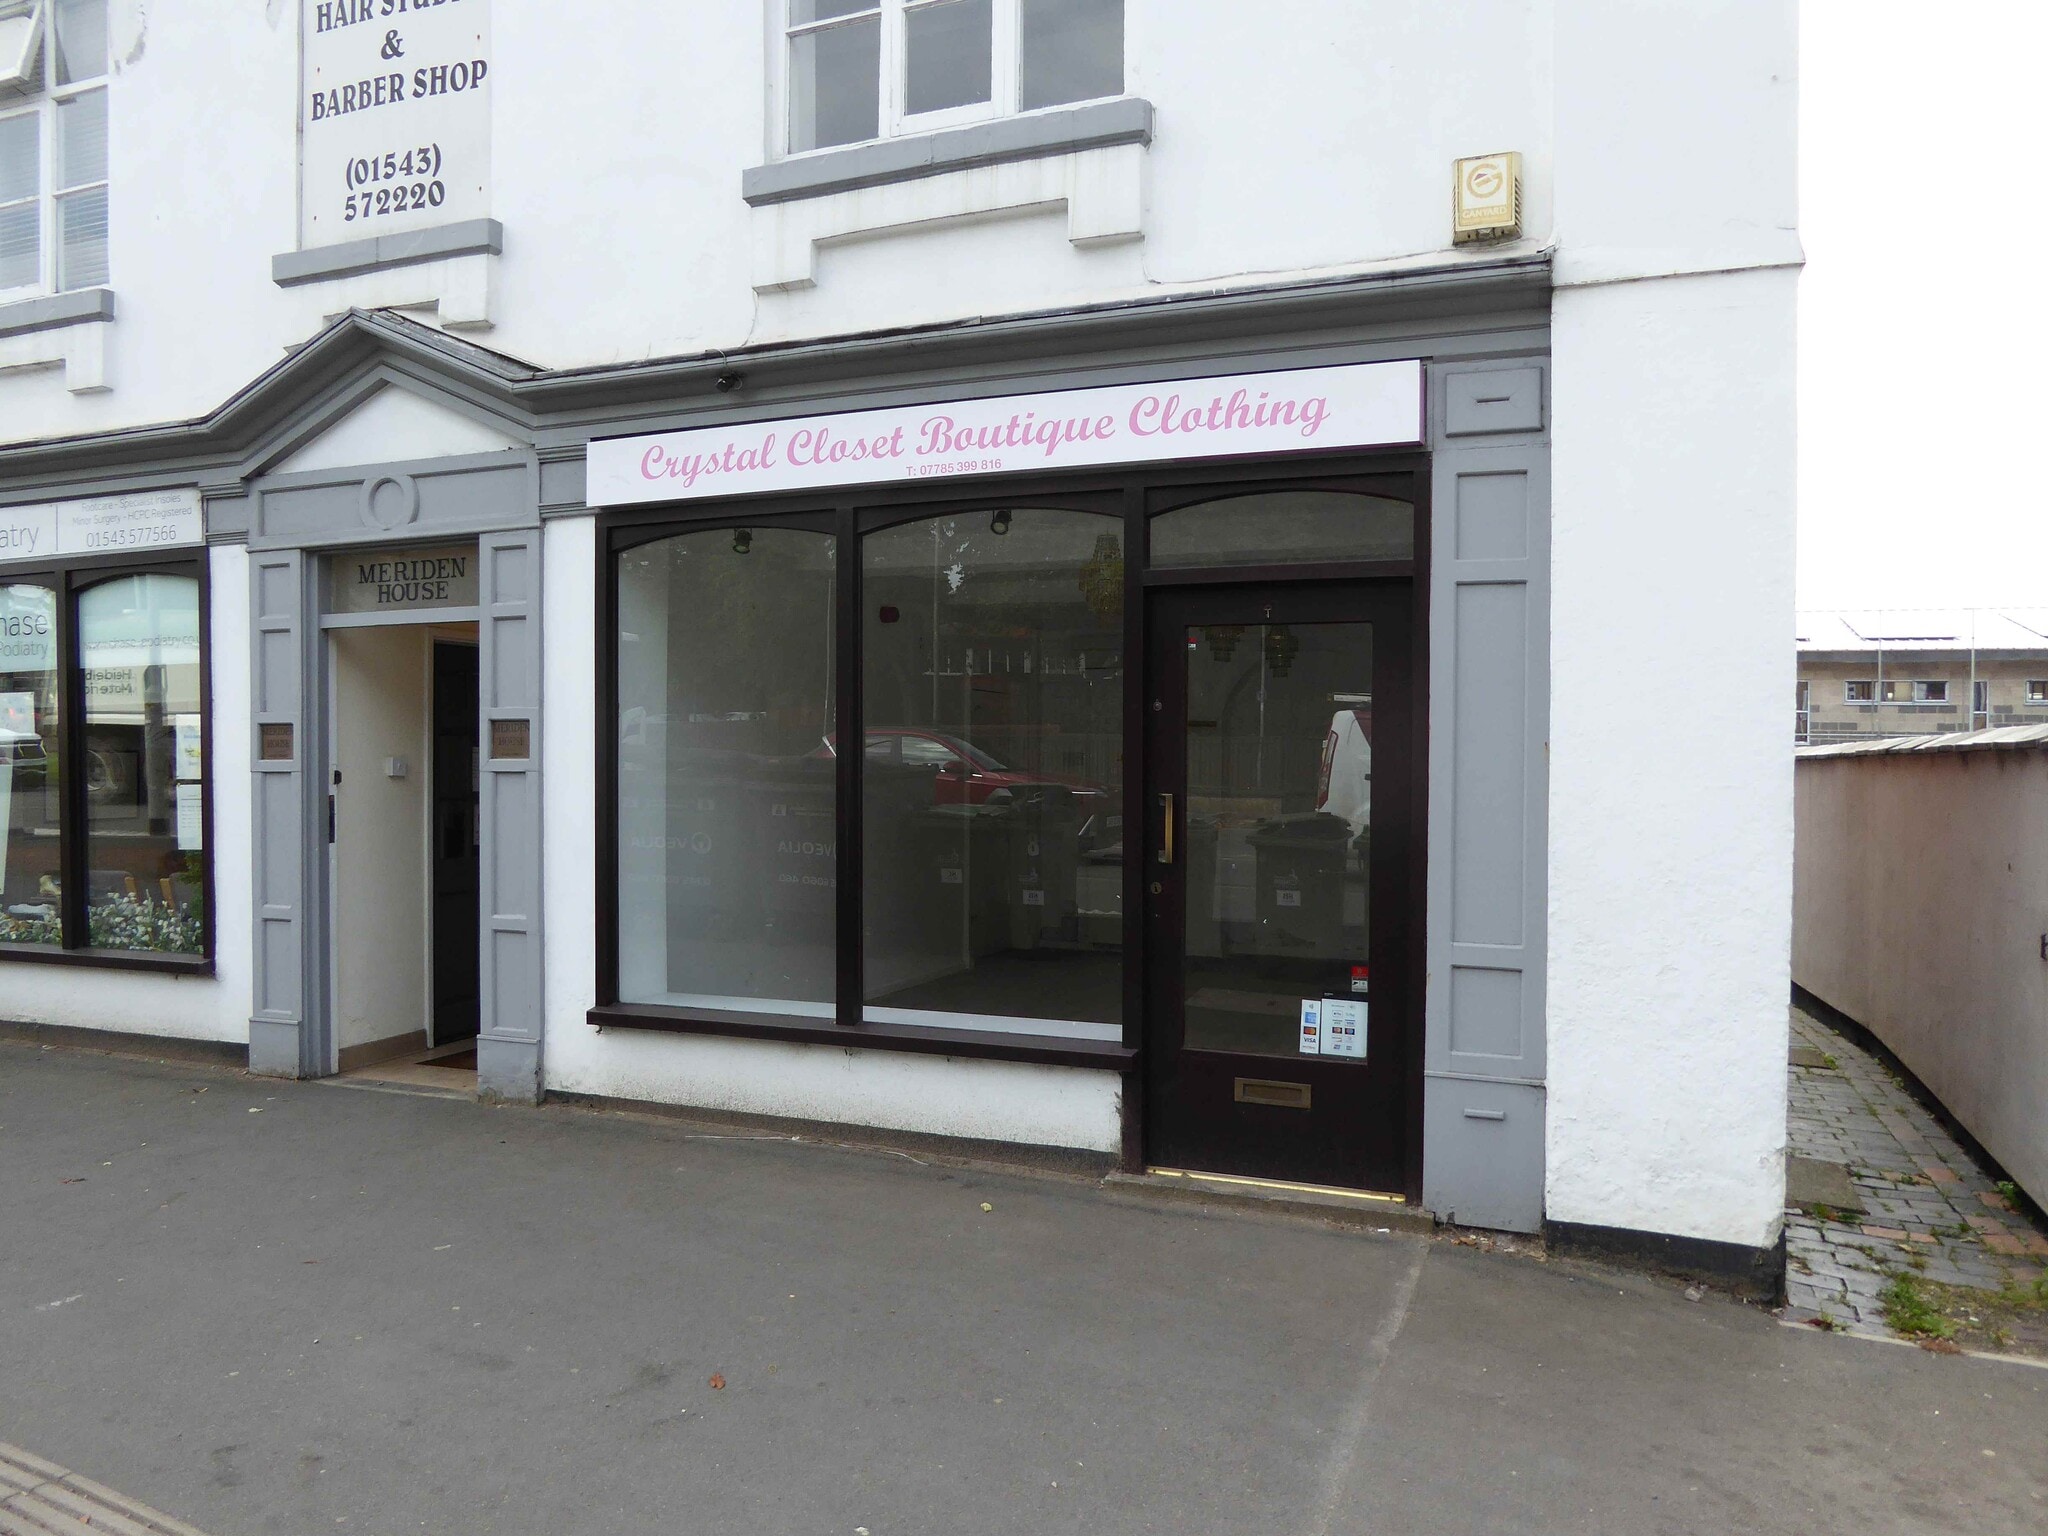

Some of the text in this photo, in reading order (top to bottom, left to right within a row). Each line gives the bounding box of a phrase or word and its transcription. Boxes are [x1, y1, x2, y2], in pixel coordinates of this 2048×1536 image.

[316, 0, 374, 33] HAIR
[380, 29, 405, 60] &
[311, 59, 488, 121] BARBER SHOP
[346, 143, 442, 191] (01543)
[344, 180, 446, 222] 572220
[641, 388, 1331, 488] Crystal Closet Boutique Clothing
[920, 463, 955, 476] 07785
[957, 460, 978, 473] 399
[981, 458, 1002, 470] 816
[152, 507, 192, 519] Registered
[86, 524, 177, 547] 01543 577566
[358, 557, 466, 584] MERIDEN
[377, 581, 449, 603] HOUSE
